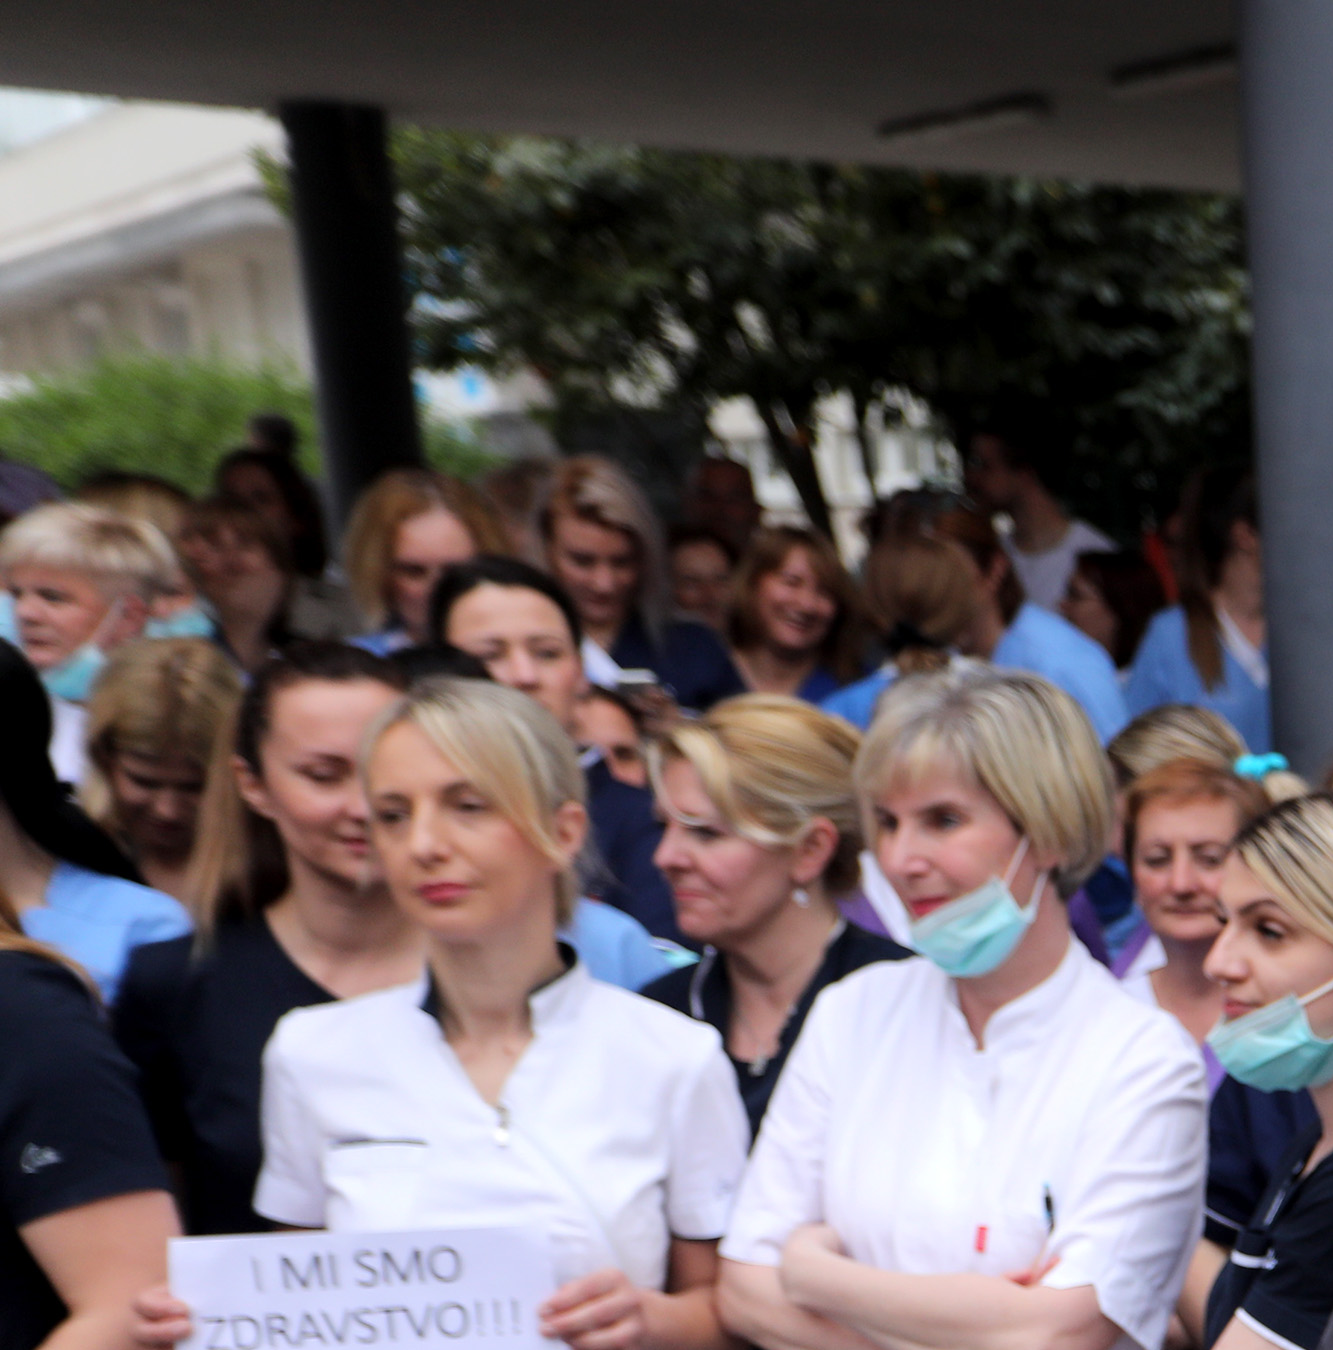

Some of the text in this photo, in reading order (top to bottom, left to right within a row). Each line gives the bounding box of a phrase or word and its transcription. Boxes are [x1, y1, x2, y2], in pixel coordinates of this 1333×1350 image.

[249, 1244, 464, 1292] I MI SMO
